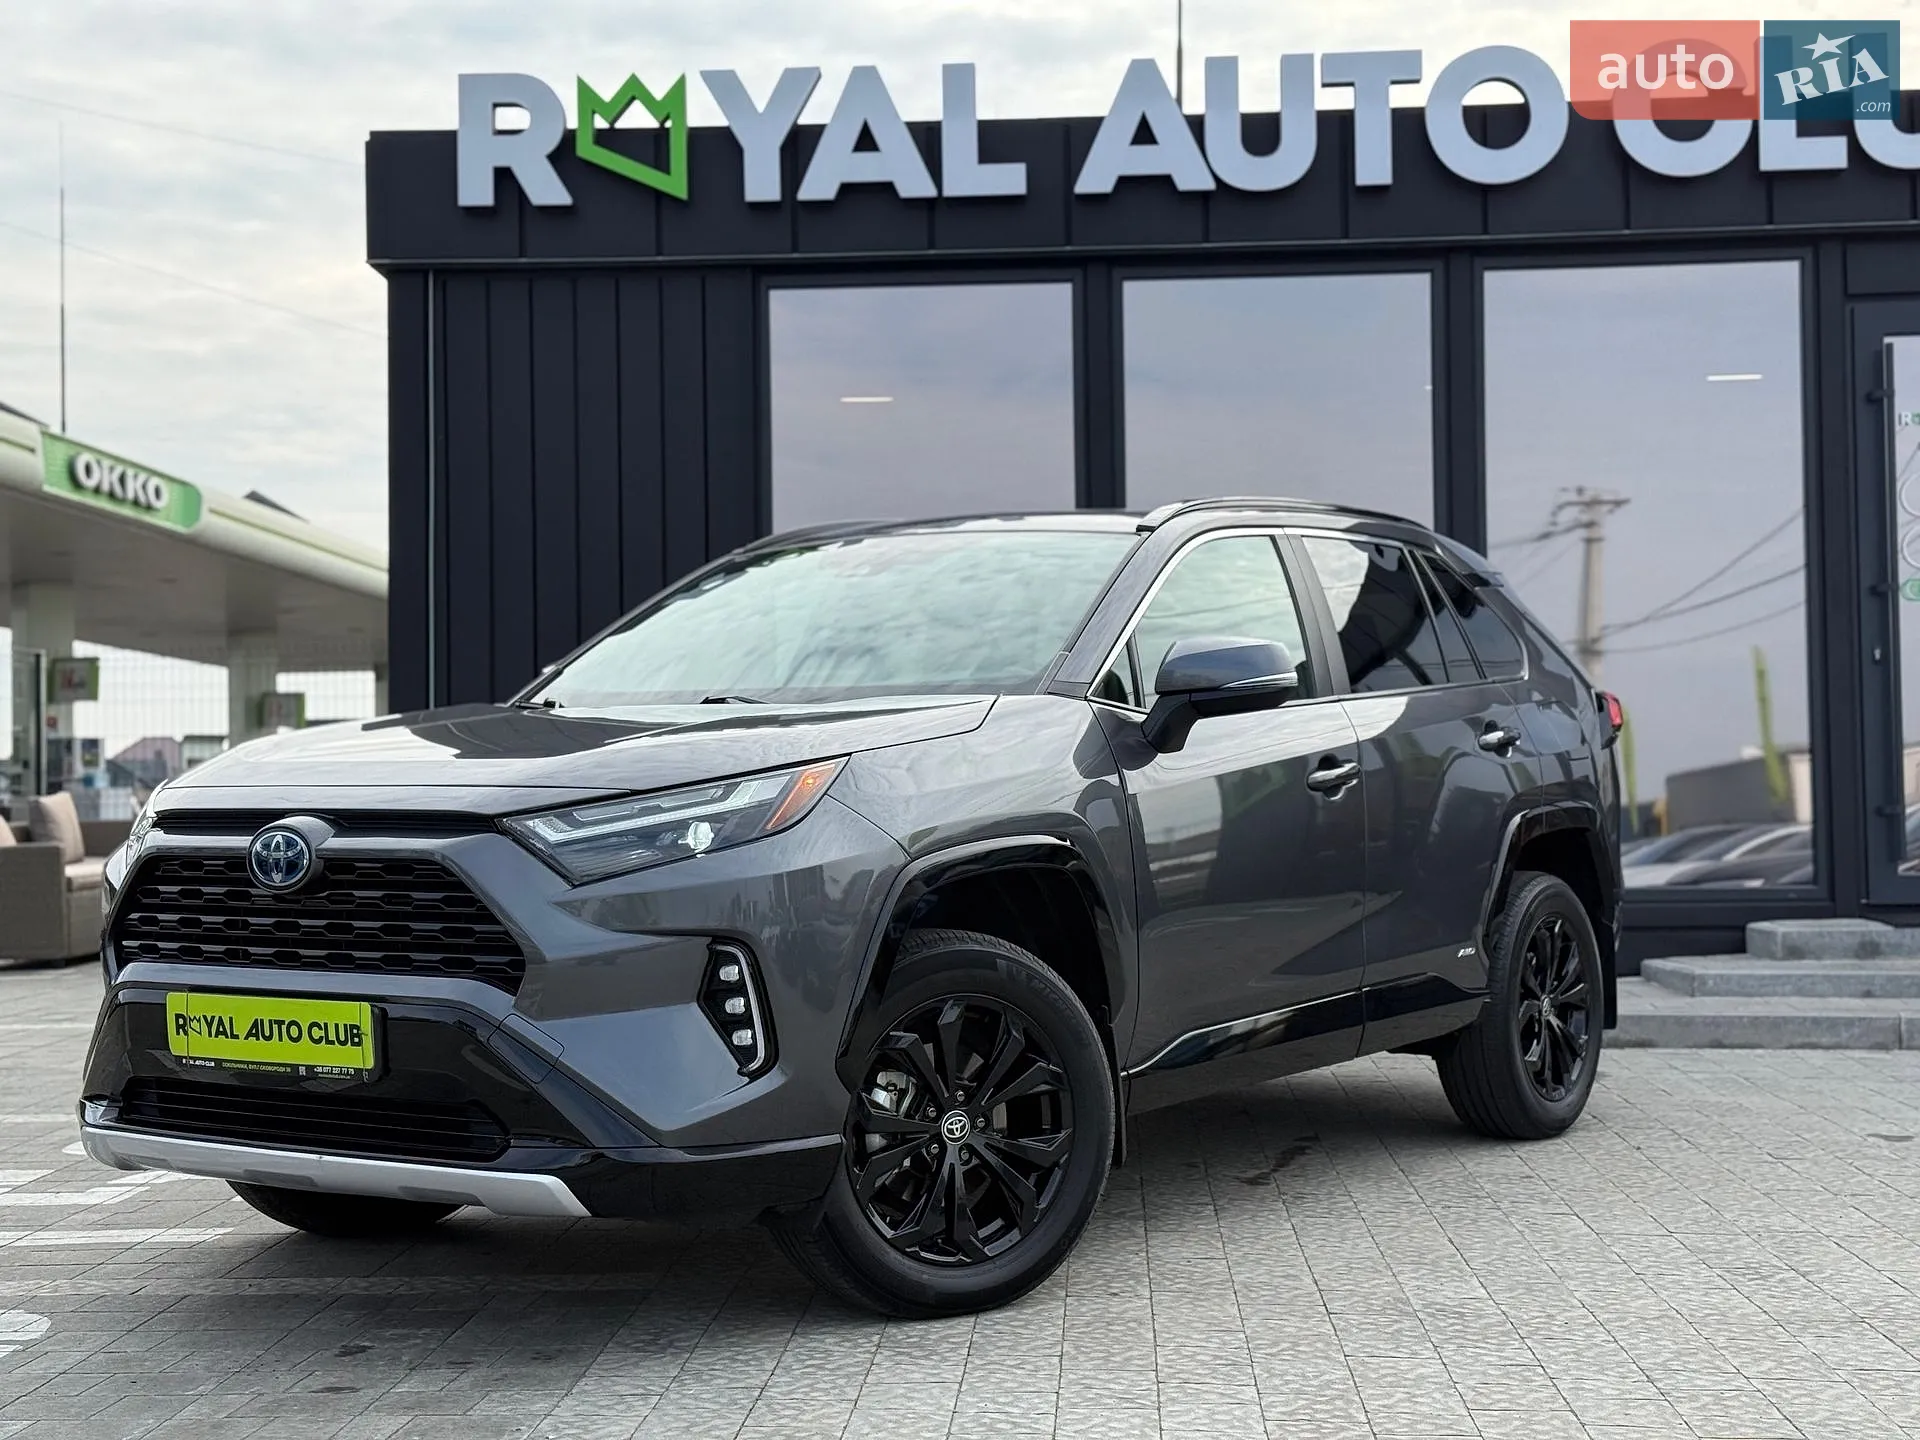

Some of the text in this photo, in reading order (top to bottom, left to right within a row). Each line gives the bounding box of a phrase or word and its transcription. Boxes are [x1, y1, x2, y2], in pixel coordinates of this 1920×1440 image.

[1073, 45, 1569, 194] AUTO
[72, 452, 170, 509] OKKO
[243, 1018, 303, 1043] AUTO
[307, 1021, 363, 1047] CLUB
